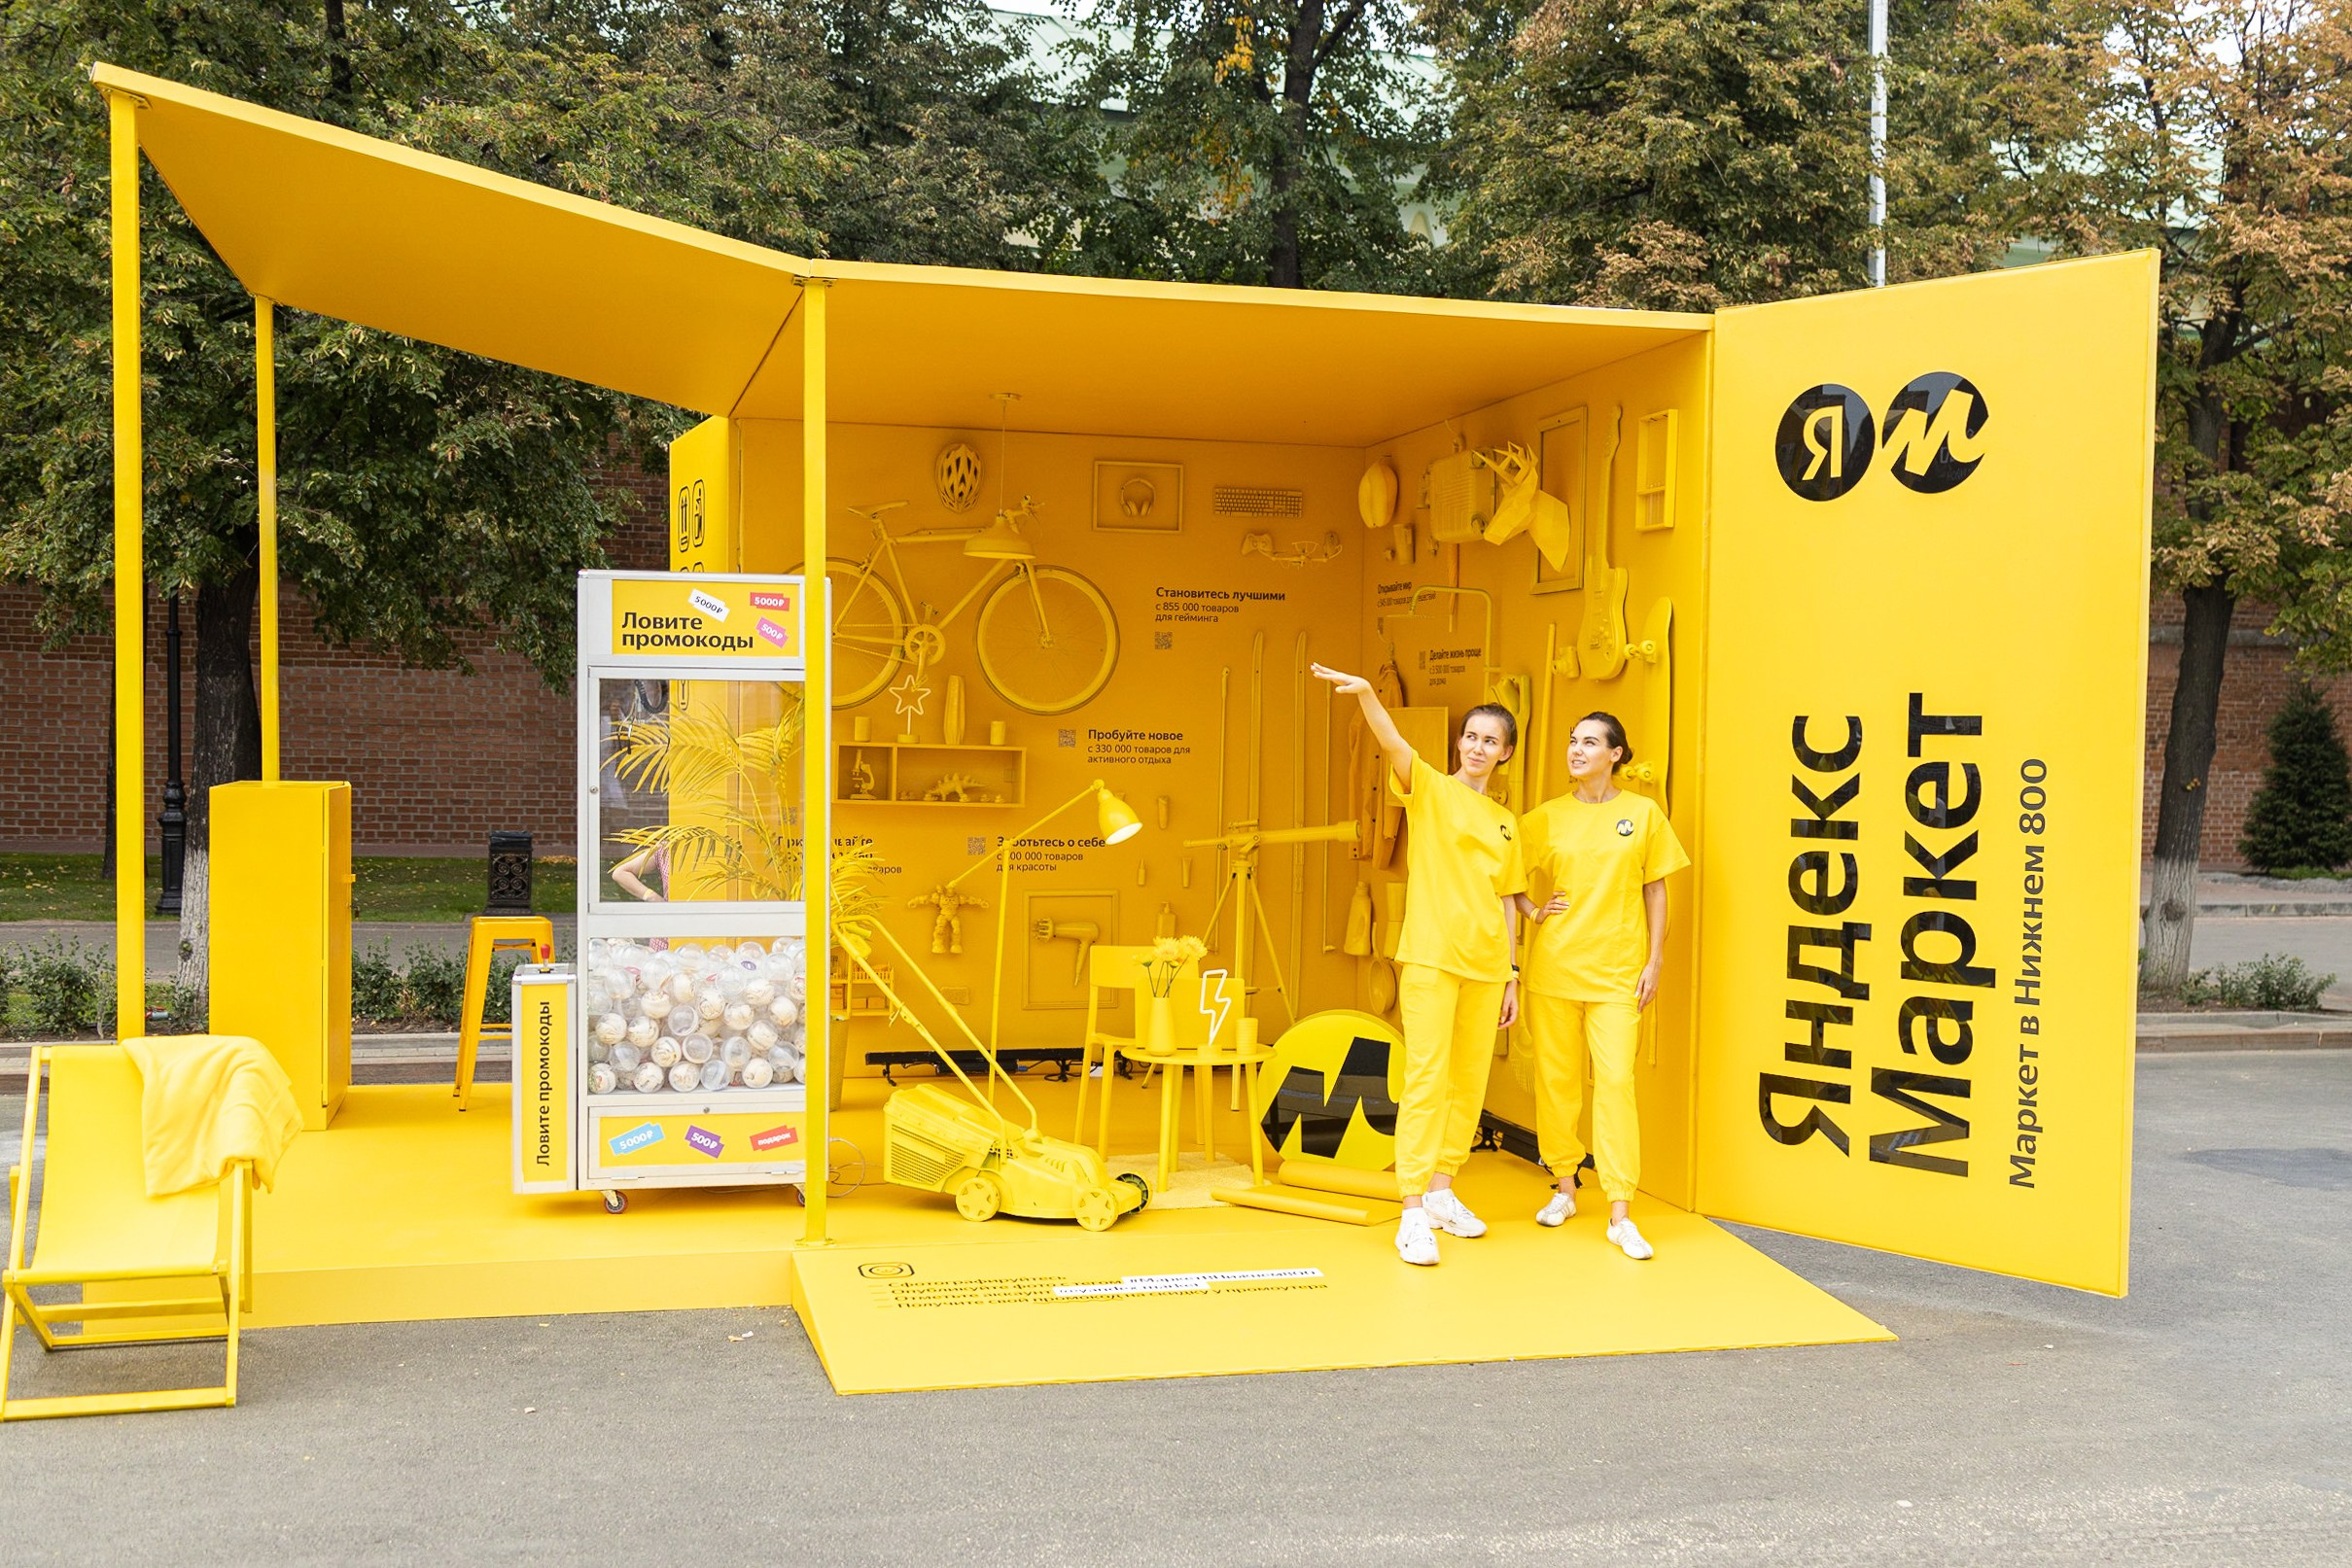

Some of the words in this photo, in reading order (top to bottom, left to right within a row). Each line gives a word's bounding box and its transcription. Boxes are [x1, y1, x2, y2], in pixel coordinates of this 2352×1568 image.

[1155, 587, 1230, 600] Становитесь
[1232, 591, 1286, 602] лучшими
[1162, 602, 1179, 611] 855
[1182, 603, 1200, 611] 000
[1201, 605, 1240, 613] товаров
[621, 611, 703, 630] Ловите
[1155, 613, 1173, 622] для
[1175, 613, 1218, 622] гейминга
[621, 634, 754, 651] промокоды
[1088, 729, 1145, 742] Пробуйте
[1148, 732, 1183, 741] новое
[1095, 745, 1112, 753] 330
[1114, 745, 1132, 753] 000
[1134, 747, 1172, 755] товаров
[1138, 756, 1172, 765] отдыха
[2019, 758, 2047, 835] 800
[997, 836, 1065, 848] Зотьтесь
[1068, 839, 1074, 848] о
[1077, 837, 1106, 848] себе
[1025, 852, 1042, 860] 000
[1016, 864, 1057, 873] красоты
[2014, 846, 2045, 1006] Нижнем
[1759, 715, 1872, 1158] Яндекс
[1869, 692, 1996, 1178] Маркет
[2019, 1016, 2040, 1035] в
[540, 1001, 553, 1101] промокоды
[2009, 1043, 2043, 1189] Маркет
[536, 1105, 550, 1167] Ловите
[888, 1275, 1067, 1288] Сфотографируйтесь
[891, 1284, 1009, 1294] Опубликуйте
[1033, 1293, 1123, 1303] промокод
[1149, 1289, 1209, 1298] скидку
[1226, 1283, 1328, 1293] промоутера
